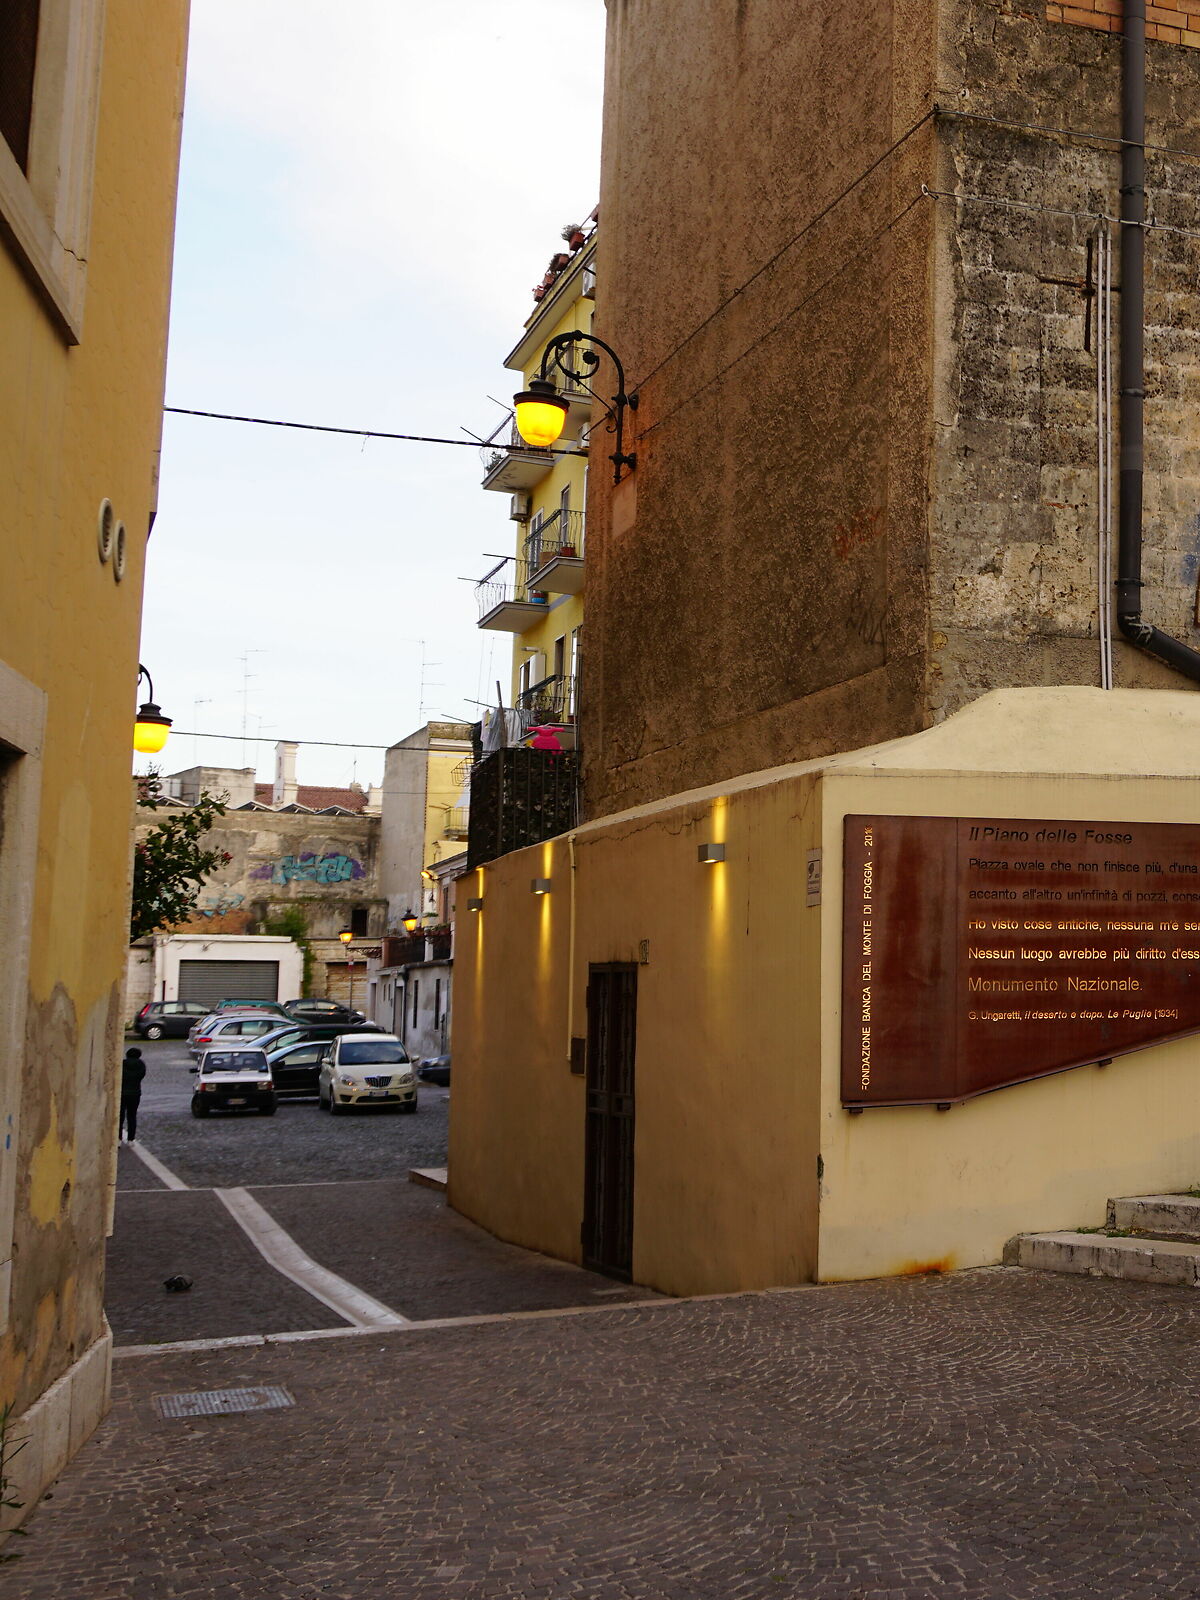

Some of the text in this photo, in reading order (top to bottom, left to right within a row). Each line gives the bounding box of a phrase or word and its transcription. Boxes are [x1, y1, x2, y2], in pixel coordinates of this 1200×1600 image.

[969, 827, 1133, 845] Il Piano delle Fosse
[969, 858, 1008, 871] Piazza
[1014, 859, 1045, 871] ovale
[1051, 860, 1071, 871] che
[1078, 863, 1098, 872] non
[1104, 861, 1139, 872] finisce
[1146, 862, 1164, 875] più,
[1169, 863, 1198, 873] d'una
[863, 862, 873, 899] FOGGIA
[969, 890, 1016, 900] accanto
[1022, 889, 1062, 900] all'altro
[1068, 890, 1118, 901] un'infinità
[1123, 891, 1132, 901] di
[1137, 892, 1168, 904] pozzi,
[863, 904, 872, 914] DI
[968, 920, 986, 930] Ho
[991, 919, 1018, 930] visto
[1024, 921, 1052, 930] cose
[1058, 919, 1102, 932] antiche,
[1107, 921, 1154, 931] nessuna
[862, 920, 872, 955] MONTE
[968, 948, 1015, 960] Nessun
[1021, 948, 1053, 962] luogo
[1059, 948, 1107, 960] avrebbe
[1113, 948, 1130, 962] più
[1135, 948, 1166, 960] diritto
[862, 961, 872, 981] DEL
[968, 977, 1144, 991] Monumento Nazionale.
[861, 986, 872, 1022] BANCA
[968, 1011, 979, 1020] G.
[981, 1011, 1022, 1022] Ungaretti,
[1031, 1011, 1068, 1020] deserto
[1079, 1011, 1104, 1022] dopo.
[1107, 1010, 1119, 1019] Le
[1122, 1010, 1152, 1021] Puglie
[1155, 1009, 1178, 1020] [1934]
[861, 1027, 872, 1090] FONDAZIONE
